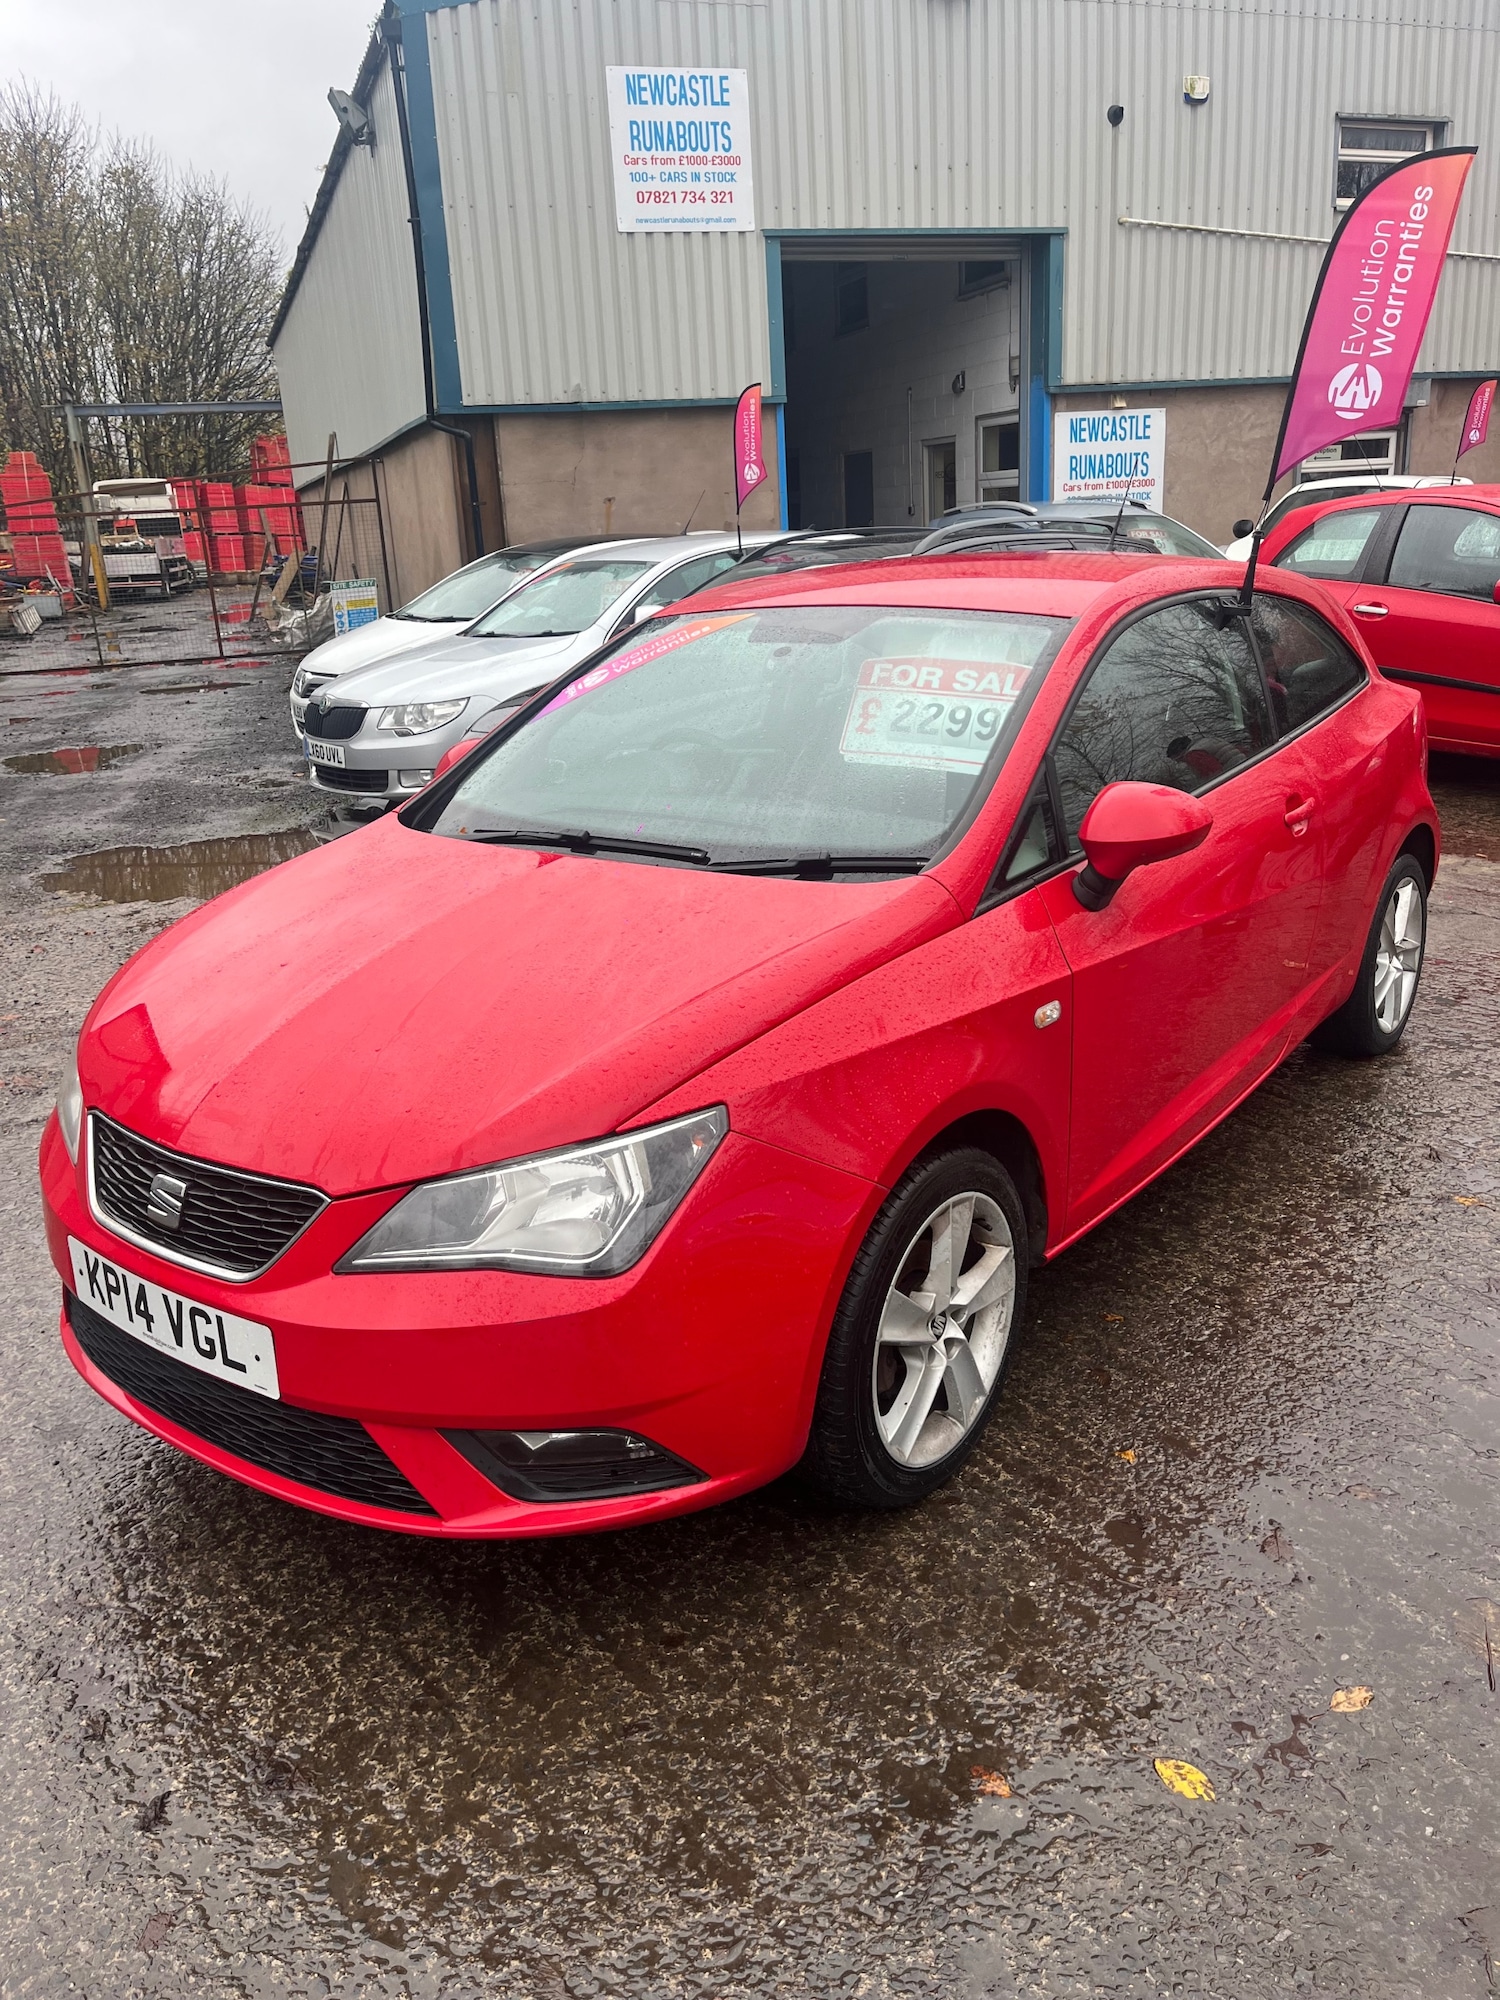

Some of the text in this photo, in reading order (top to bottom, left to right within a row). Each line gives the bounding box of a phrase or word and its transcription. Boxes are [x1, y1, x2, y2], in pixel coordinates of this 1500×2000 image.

[625, 74, 730, 107] NEWCASTLE
[629, 120, 732, 153] RUNABOUTS
[623, 155, 741, 166] Cars from £1000-£3000
[629, 172, 737, 183] 100+ CARS IN STOCK
[636, 191, 734, 204] 07821 734 321
[1340, 218, 1395, 355] Evolution
[1369, 185, 1434, 358] Warranties
[742, 411, 750, 461] Evolution
[749, 398, 757, 461] Warranties
[1069, 414, 1151, 443] NEWCASTLE
[1069, 451, 1149, 480] RUNABOUTS
[1063, 482, 1082, 492] Cars
[1084, 481, 1103, 491] from
[348, 580, 374, 588] SAFETY
[611, 630, 687, 669] Evolution
[613, 625, 711, 673] Warranties
[870, 663, 1021, 696] FOR SAL
[855, 697, 1002, 741] £ 2299
[325, 746, 343, 764] UVL
[84, 1250, 247, 1374] KP14 VGL
